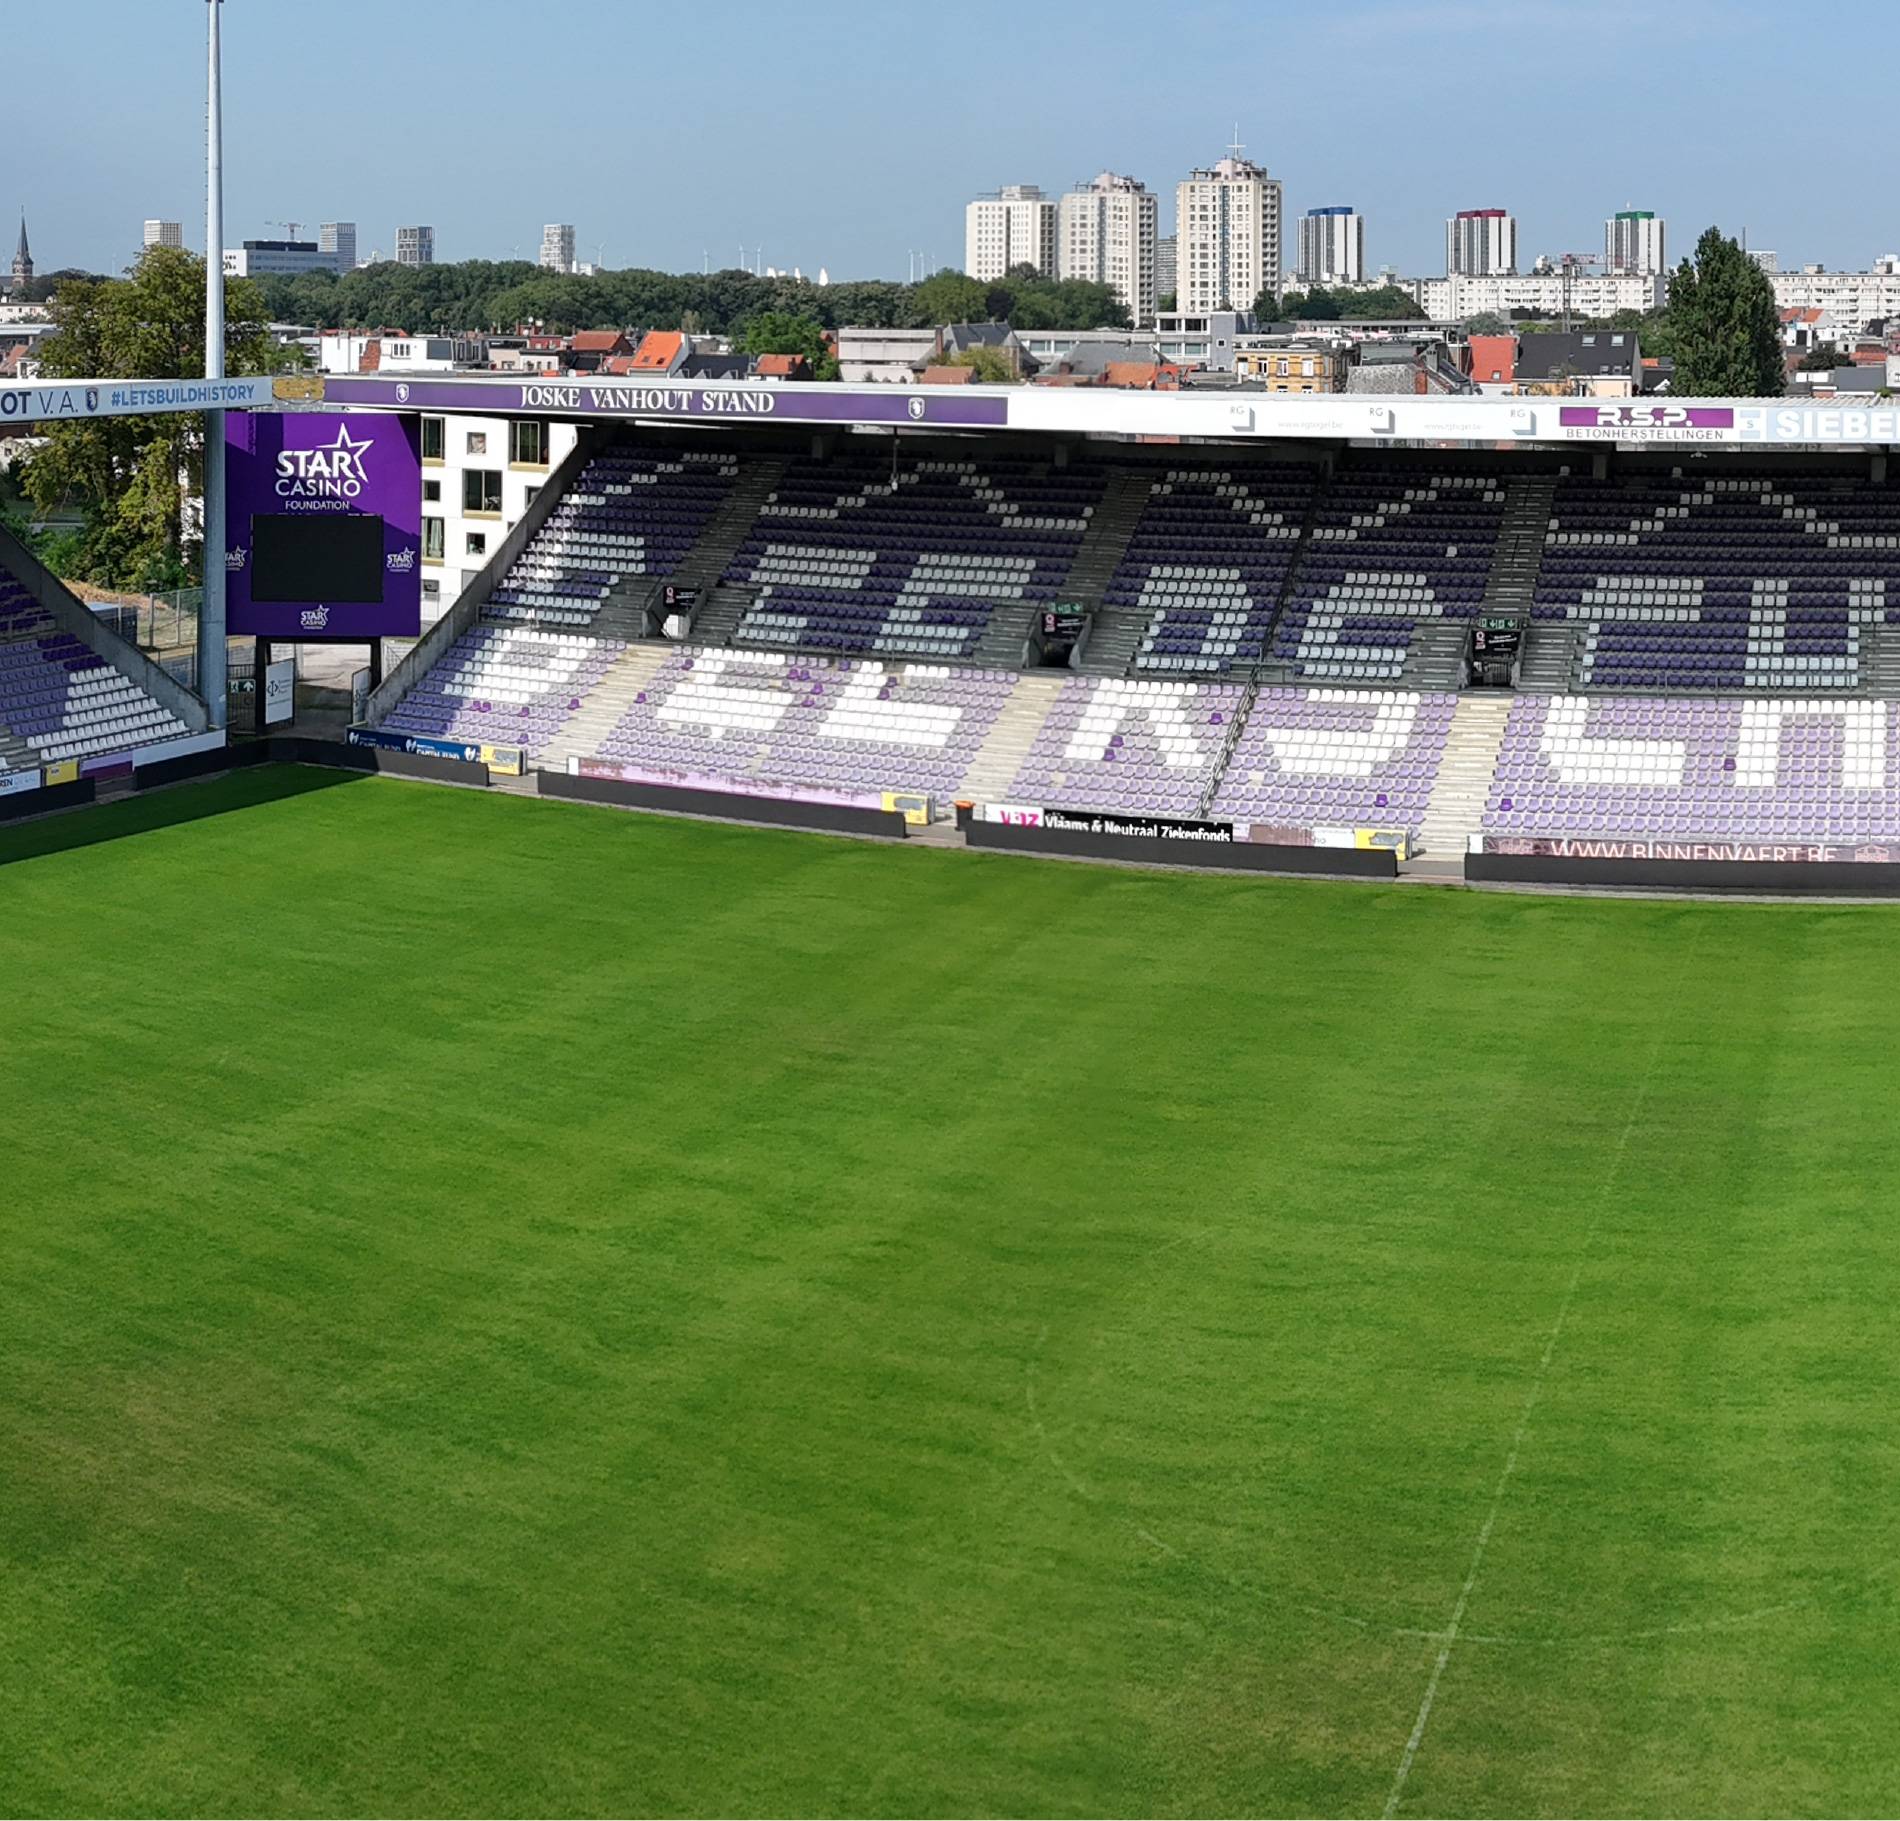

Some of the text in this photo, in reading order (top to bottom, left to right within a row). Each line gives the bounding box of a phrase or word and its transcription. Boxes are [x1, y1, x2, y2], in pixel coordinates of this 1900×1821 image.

[111, 384, 255, 407] #LETSBUILDHISTORY
[521, 386, 775, 413] JOSKE VANHOUT STAND
[1597, 407, 1693, 427] R.S.P.
[1566, 428, 1723, 440] BETONHERSTELLINGEN
[275, 450, 356, 479] STAR
[275, 479, 361, 497] CASINO
[285, 500, 350, 510] FOUNDATION
[387, 553, 411, 563] STAR
[301, 611, 325, 621] STAR
[1045, 815, 1089, 831] Vlaams
[1104, 820, 1158, 837] Neutraal
[1161, 825, 1231, 842] Ziekenfonds
